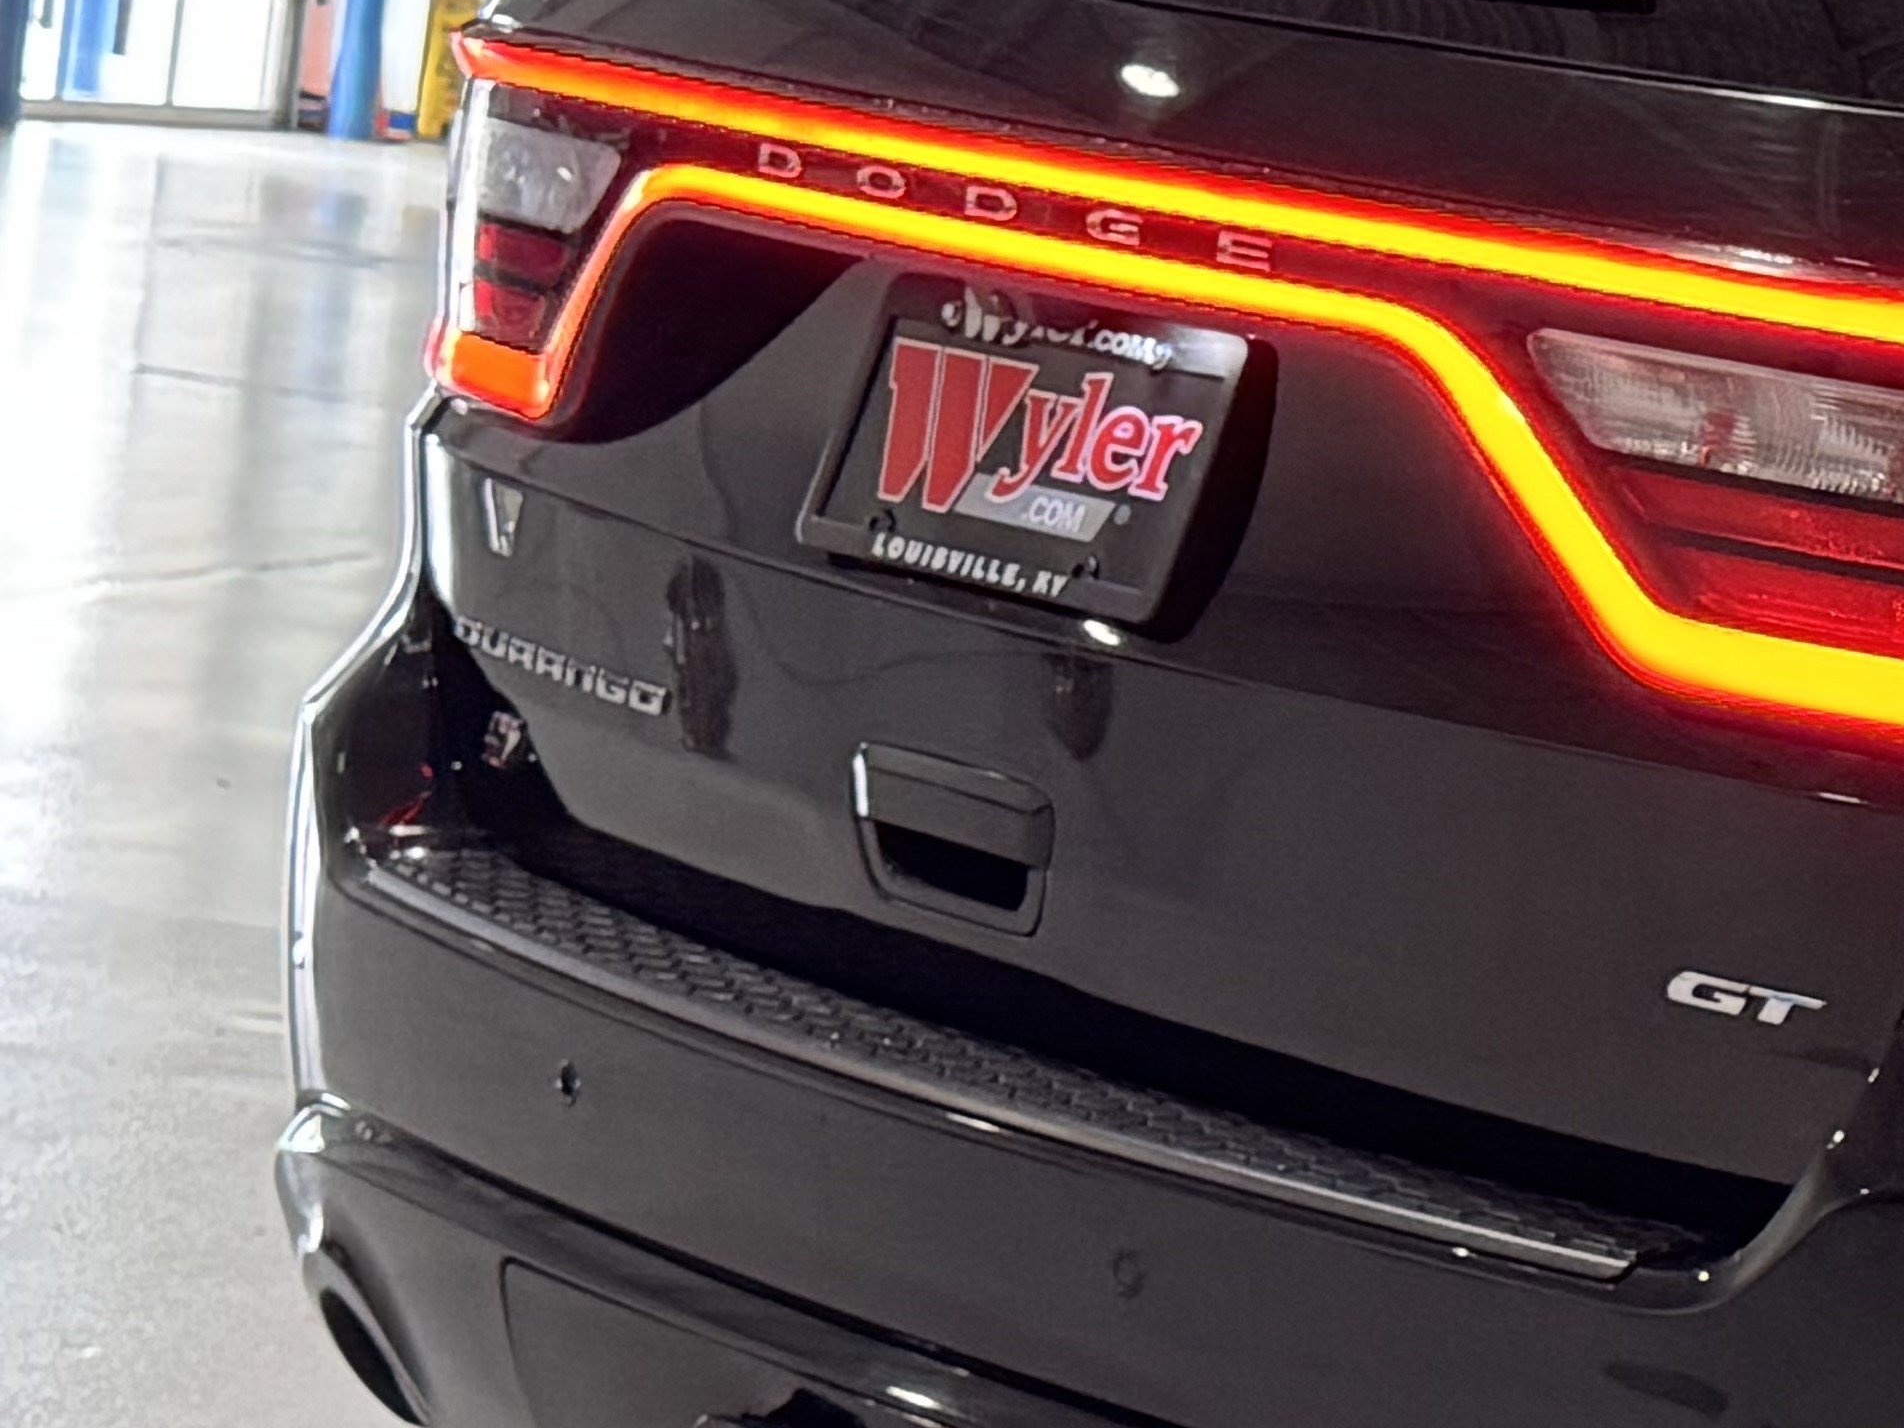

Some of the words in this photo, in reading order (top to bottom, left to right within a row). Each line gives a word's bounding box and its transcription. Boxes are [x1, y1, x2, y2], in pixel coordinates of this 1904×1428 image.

[757, 142, 1273, 273] DODGE
[877, 337, 1203, 514] Wyler
[870, 532, 1026, 592] LOUISVILLE,
[1031, 569, 1069, 598] KY
[454, 615, 667, 716] DURANGO
[1666, 970, 1828, 1026] GT
